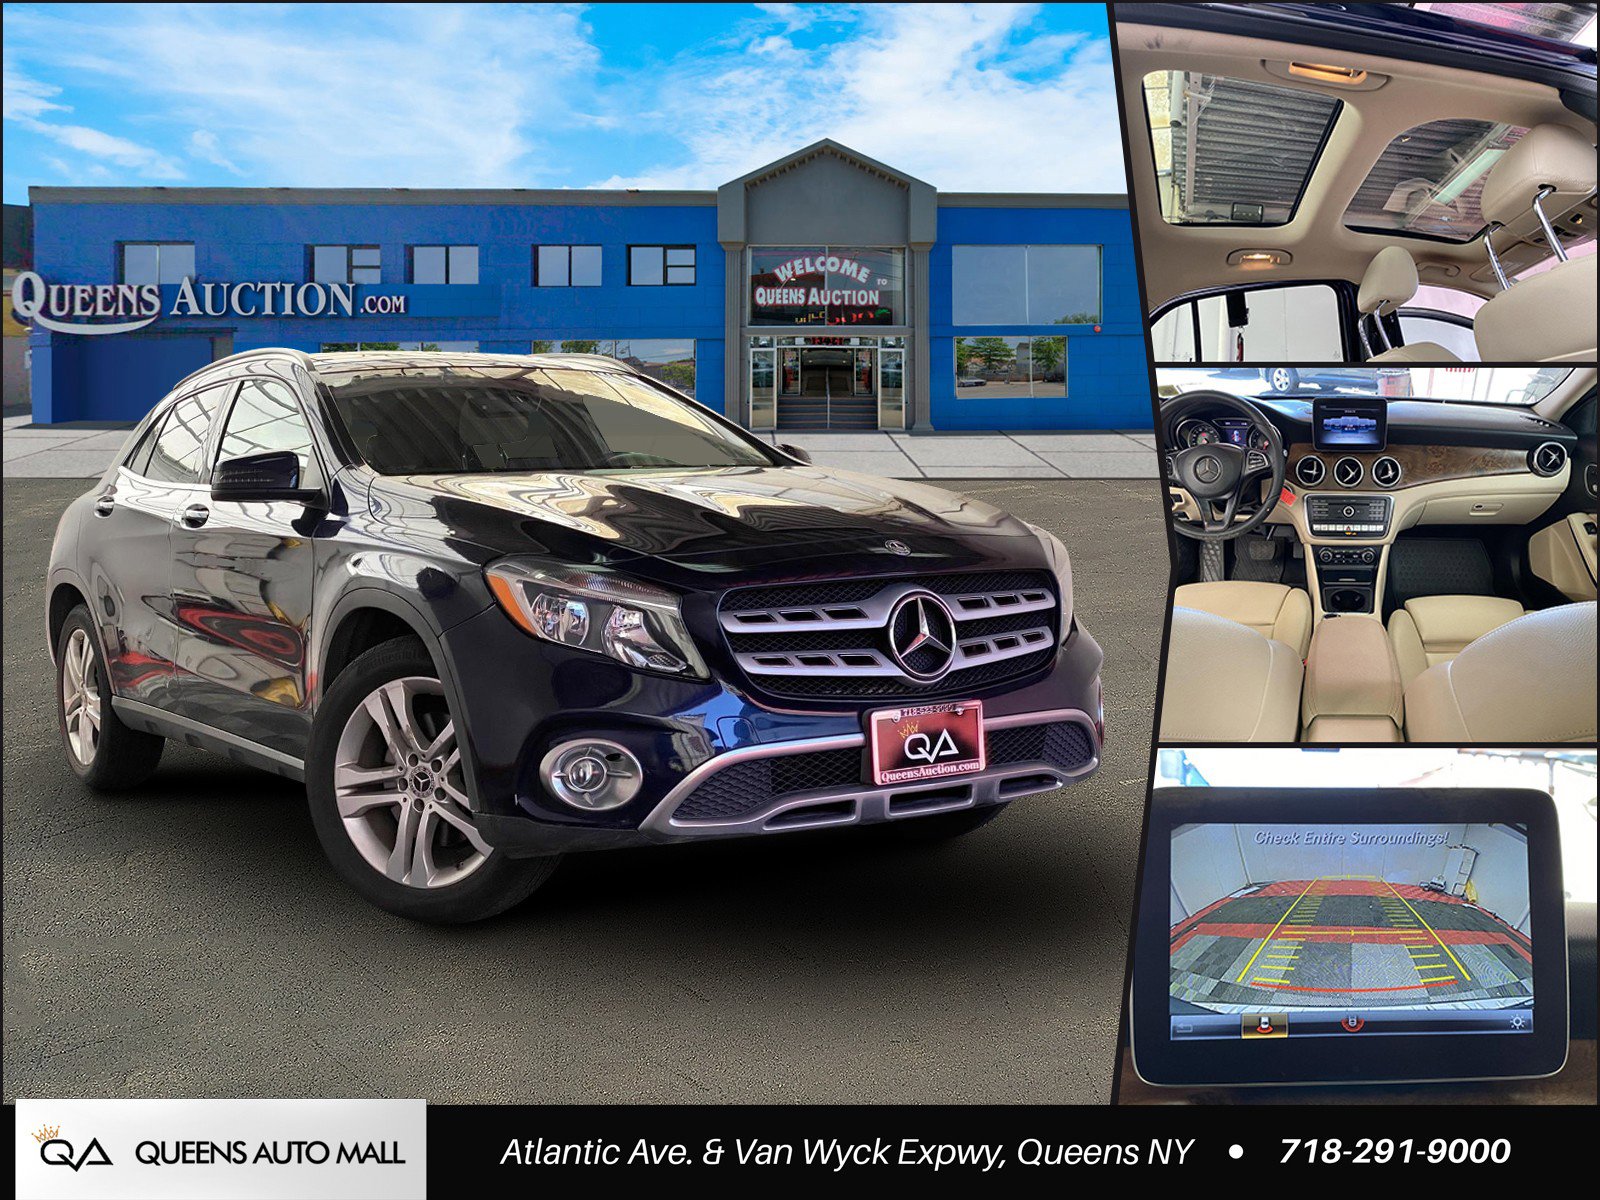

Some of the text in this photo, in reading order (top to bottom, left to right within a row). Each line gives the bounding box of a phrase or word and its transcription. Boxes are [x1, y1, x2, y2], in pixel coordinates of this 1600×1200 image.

[774, 256, 888, 286] WELCOME TO
[12, 271, 160, 334] QUEENS
[755, 287, 880, 306] QUEENS AUCTION
[904, 728, 959, 763] QA
[881, 761, 979, 783] QueensAuction.com
[1254, 830, 1450, 848] Check Entire Surroundings!
